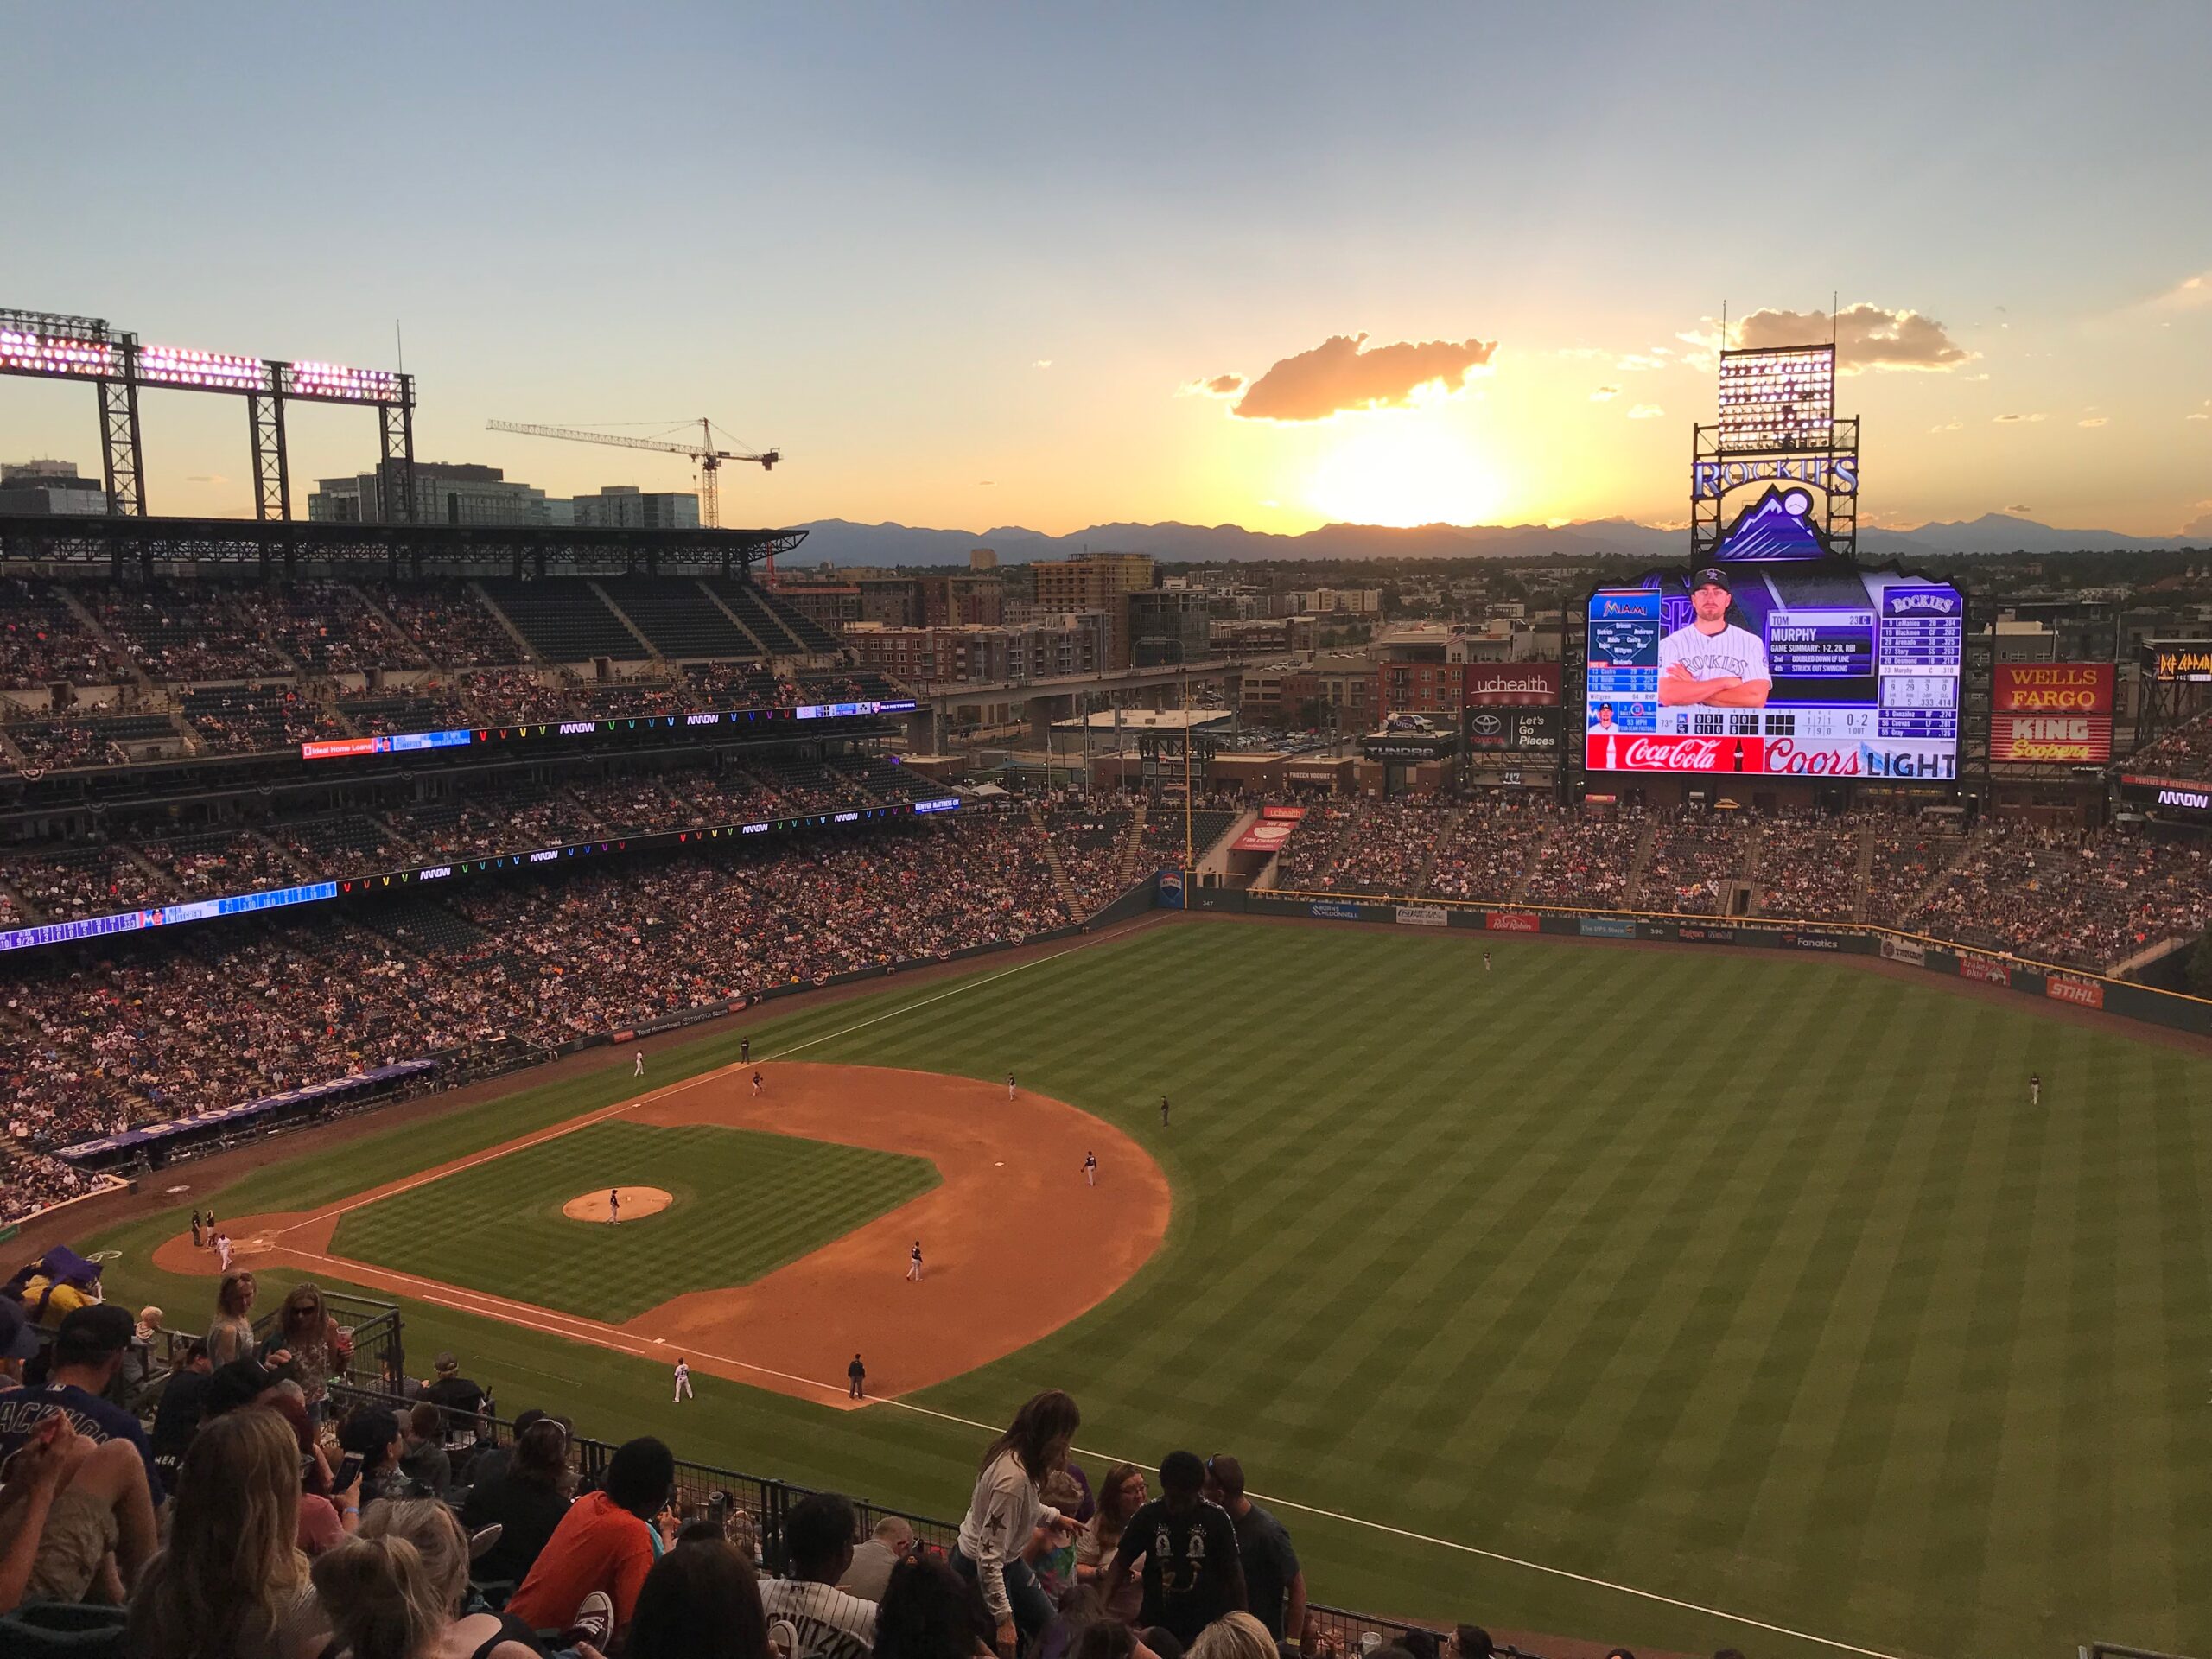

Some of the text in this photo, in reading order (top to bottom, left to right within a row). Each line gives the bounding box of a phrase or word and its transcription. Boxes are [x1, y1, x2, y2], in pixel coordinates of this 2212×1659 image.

[1694, 457, 1858, 496] ROCKIES
[1603, 600, 1647, 617] MIAMI
[1891, 594, 1954, 613] ROCKIES
[1772, 616, 1789, 625] TOM
[1771, 628, 1816, 641] MURPHY
[1679, 654, 1748, 676] ROCKIES
[2161, 653, 2177, 674] DEF
[1478, 675, 1548, 691] uchealth
[2011, 670, 2097, 684] WELLS
[2012, 691, 2095, 706] FARGO
[687, 715, 719, 725] ARROW
[1393, 720, 1417, 729] TOYOTA
[1520, 716, 1544, 726] Let's
[560, 722, 595, 734] ARROW
[1519, 726, 1534, 734] Go
[2012, 719, 2089, 740] KING
[1519, 736, 1554, 746] Places
[1368, 747, 1434, 756] TUNDRA
[1625, 738, 1722, 769] Coca-Cola
[2012, 739, 2089, 760] Soopers
[1765, 738, 1955, 777] Coors LIGHT
[2136, 777, 2158, 785] POWERED
[2170, 780, 2199, 790] RENEWABLE
[2158, 791, 2208, 808] ARROW
[835, 813, 858, 823] ARROW
[742, 823, 768, 834] ARROW
[531, 850, 558, 862] ARROW
[420, 867, 451, 880] ARROW
[243, 901, 256, 910] 3.00
[1493, 918, 1531, 930] Red Robin
[16, 937, 34, 946] 9/29
[1797, 938, 1838, 949] Fanatics
[1967, 969, 1983, 978] plus
[2051, 982, 2096, 1003] STIHL
[652, 1021, 680, 1032] Hometown
[690, 1013, 711, 1022] TOYOTA
